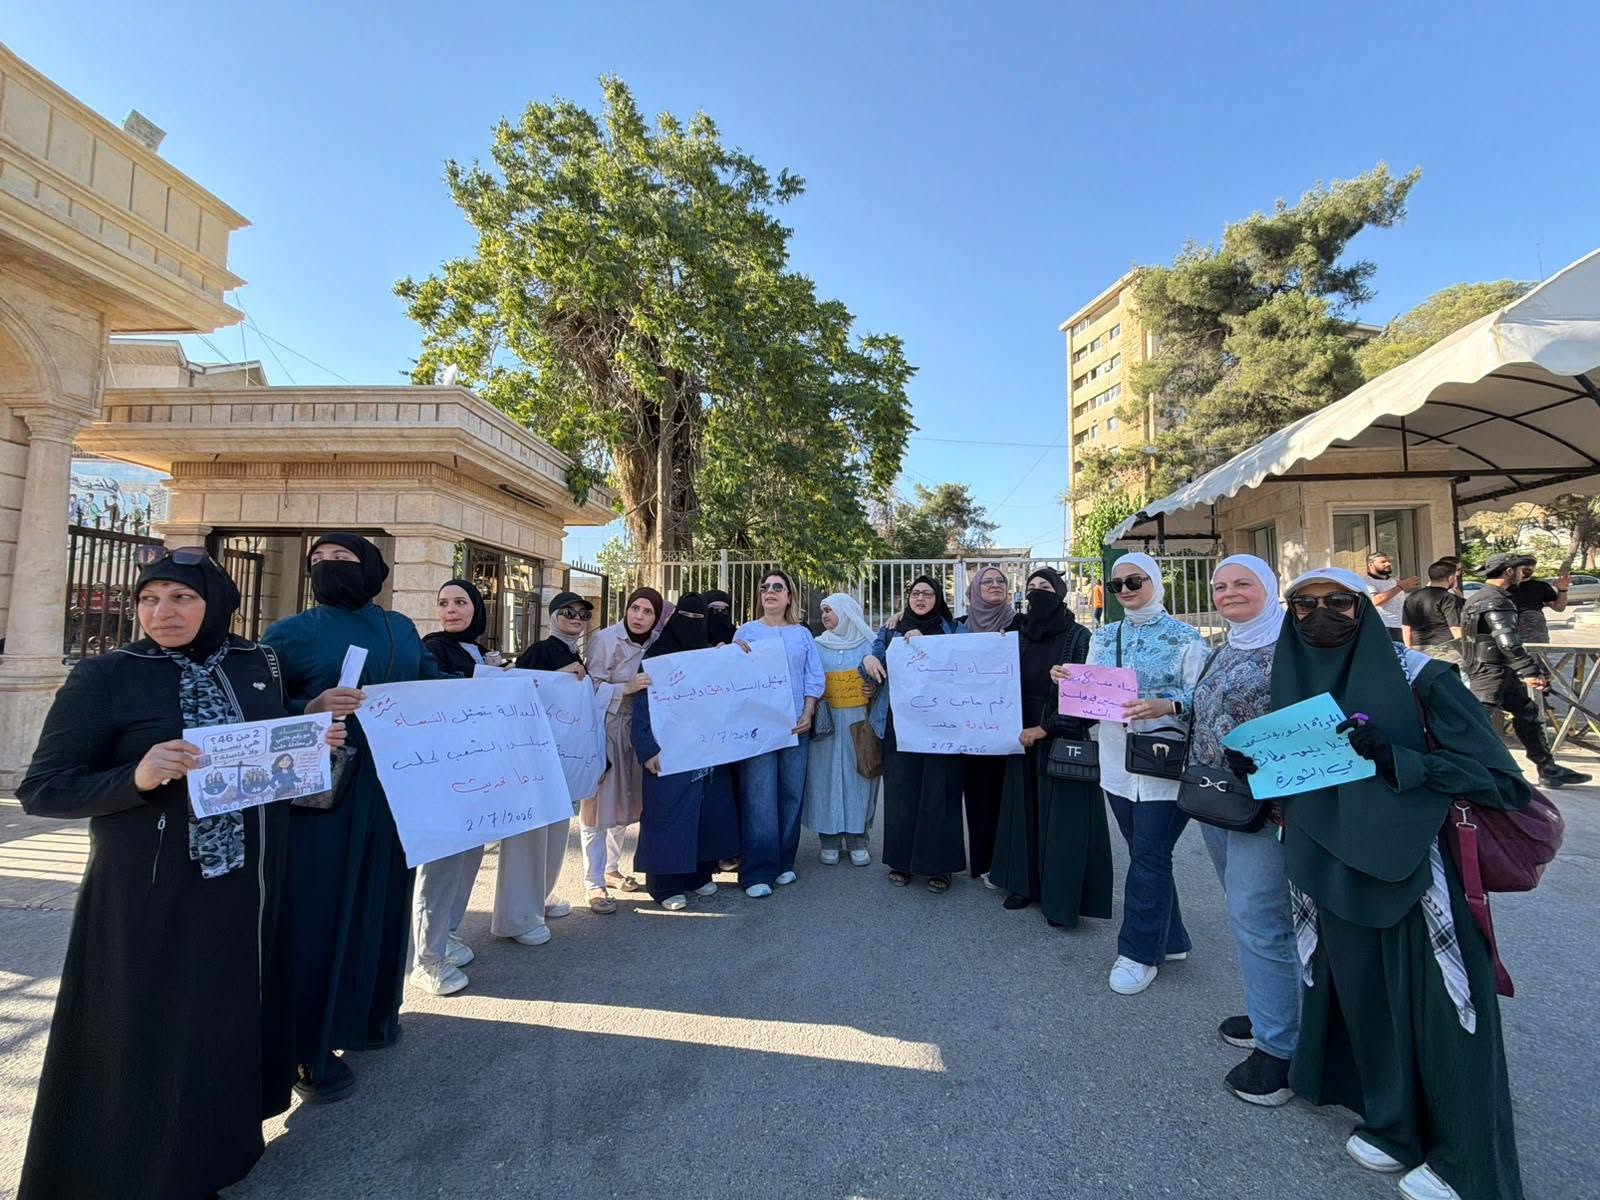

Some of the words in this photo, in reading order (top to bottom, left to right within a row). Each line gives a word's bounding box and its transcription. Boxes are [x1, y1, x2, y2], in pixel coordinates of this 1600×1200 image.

[917, 662, 958, 676] ليست
[726, 681, 761, 692] النساء
[498, 702, 540, 719] العدالة
[988, 696, 1014, 715] رقم
[394, 711, 447, 727] النساء
[235, 733, 250, 742] من
[253, 729, 260, 738] 2
[447, 739, 502, 761] الشعب
[1066, 745, 1082, 757] TF
[1326, 760, 1354, 775] في
[1276, 767, 1326, 790] الثورة
